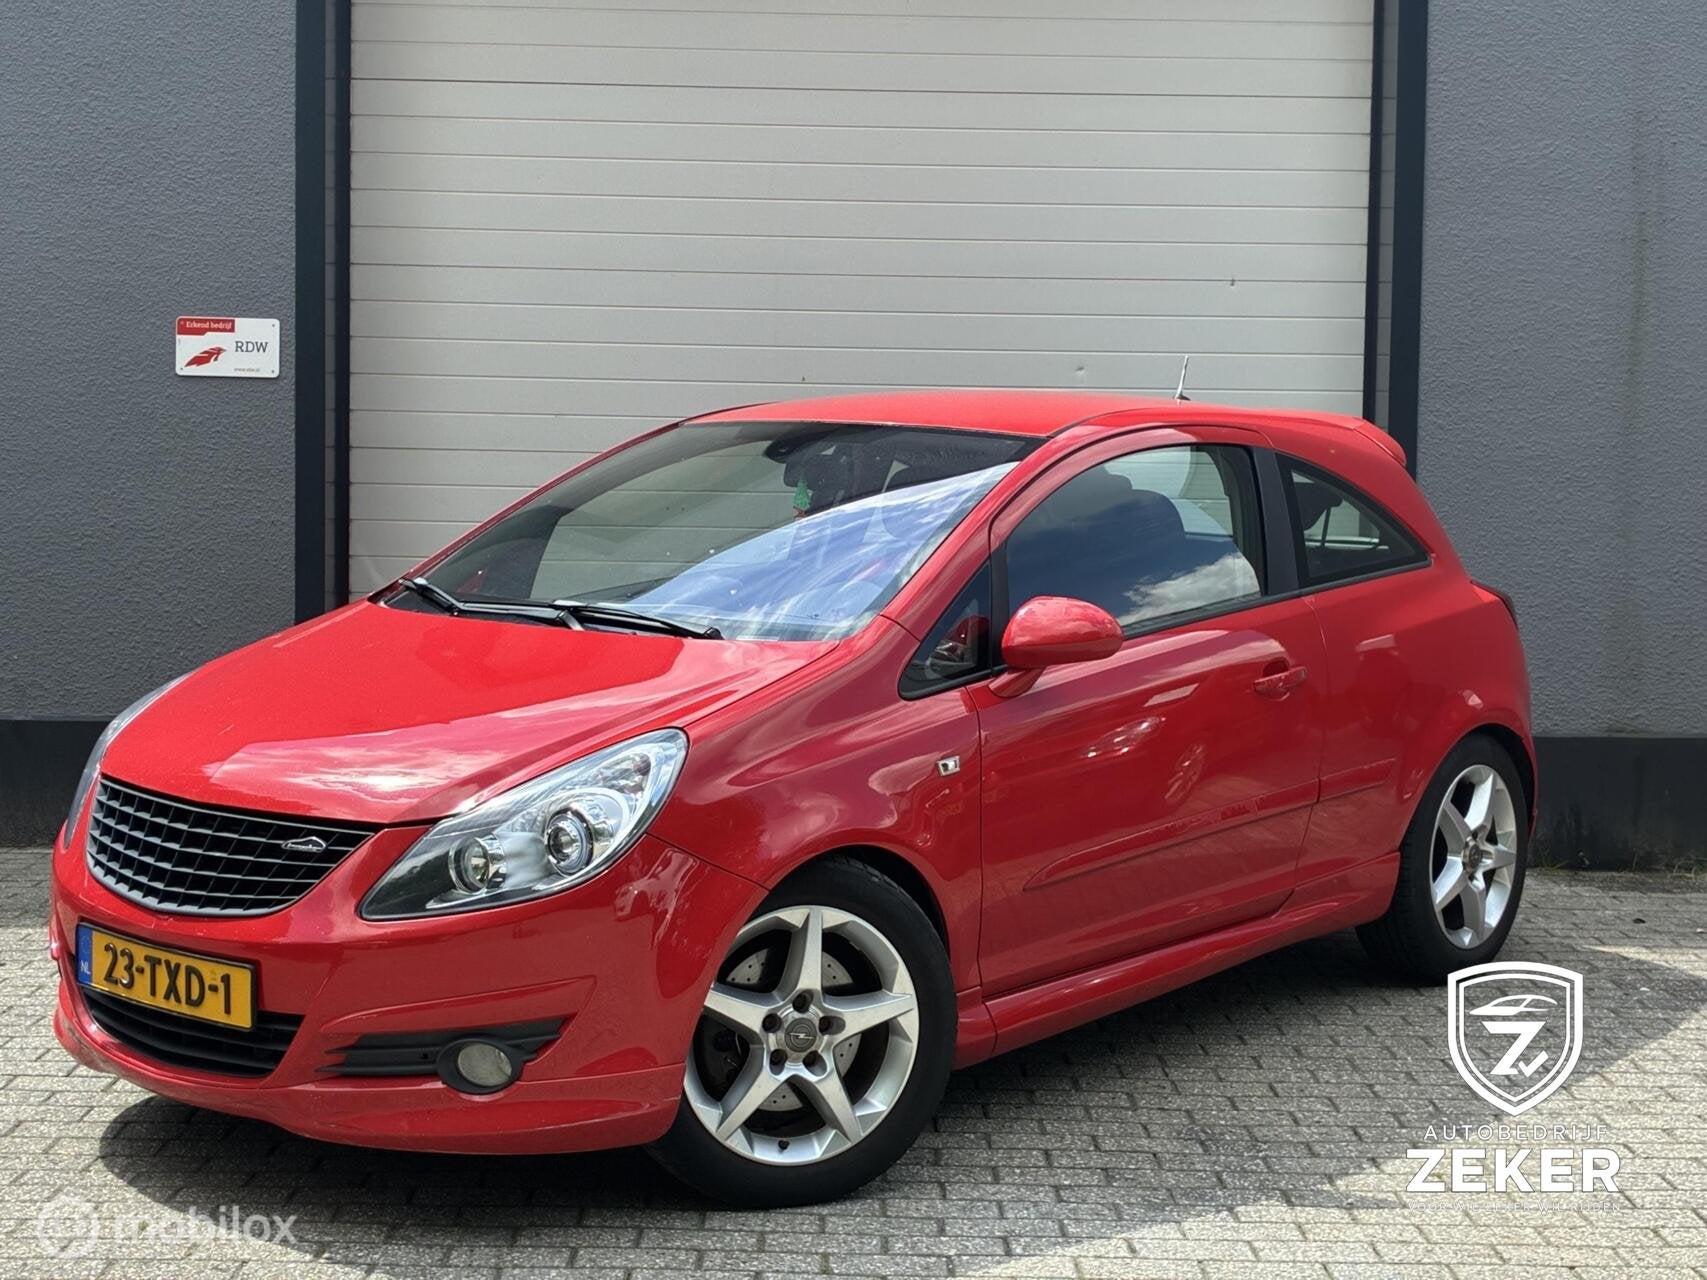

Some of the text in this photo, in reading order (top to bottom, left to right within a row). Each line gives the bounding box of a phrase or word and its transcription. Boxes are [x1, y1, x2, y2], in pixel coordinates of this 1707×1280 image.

[186, 320, 232, 330] Erkend bedrijf
[234, 341, 269, 353] RDW
[80, 942, 231, 1016] NL 23-TXD-1
